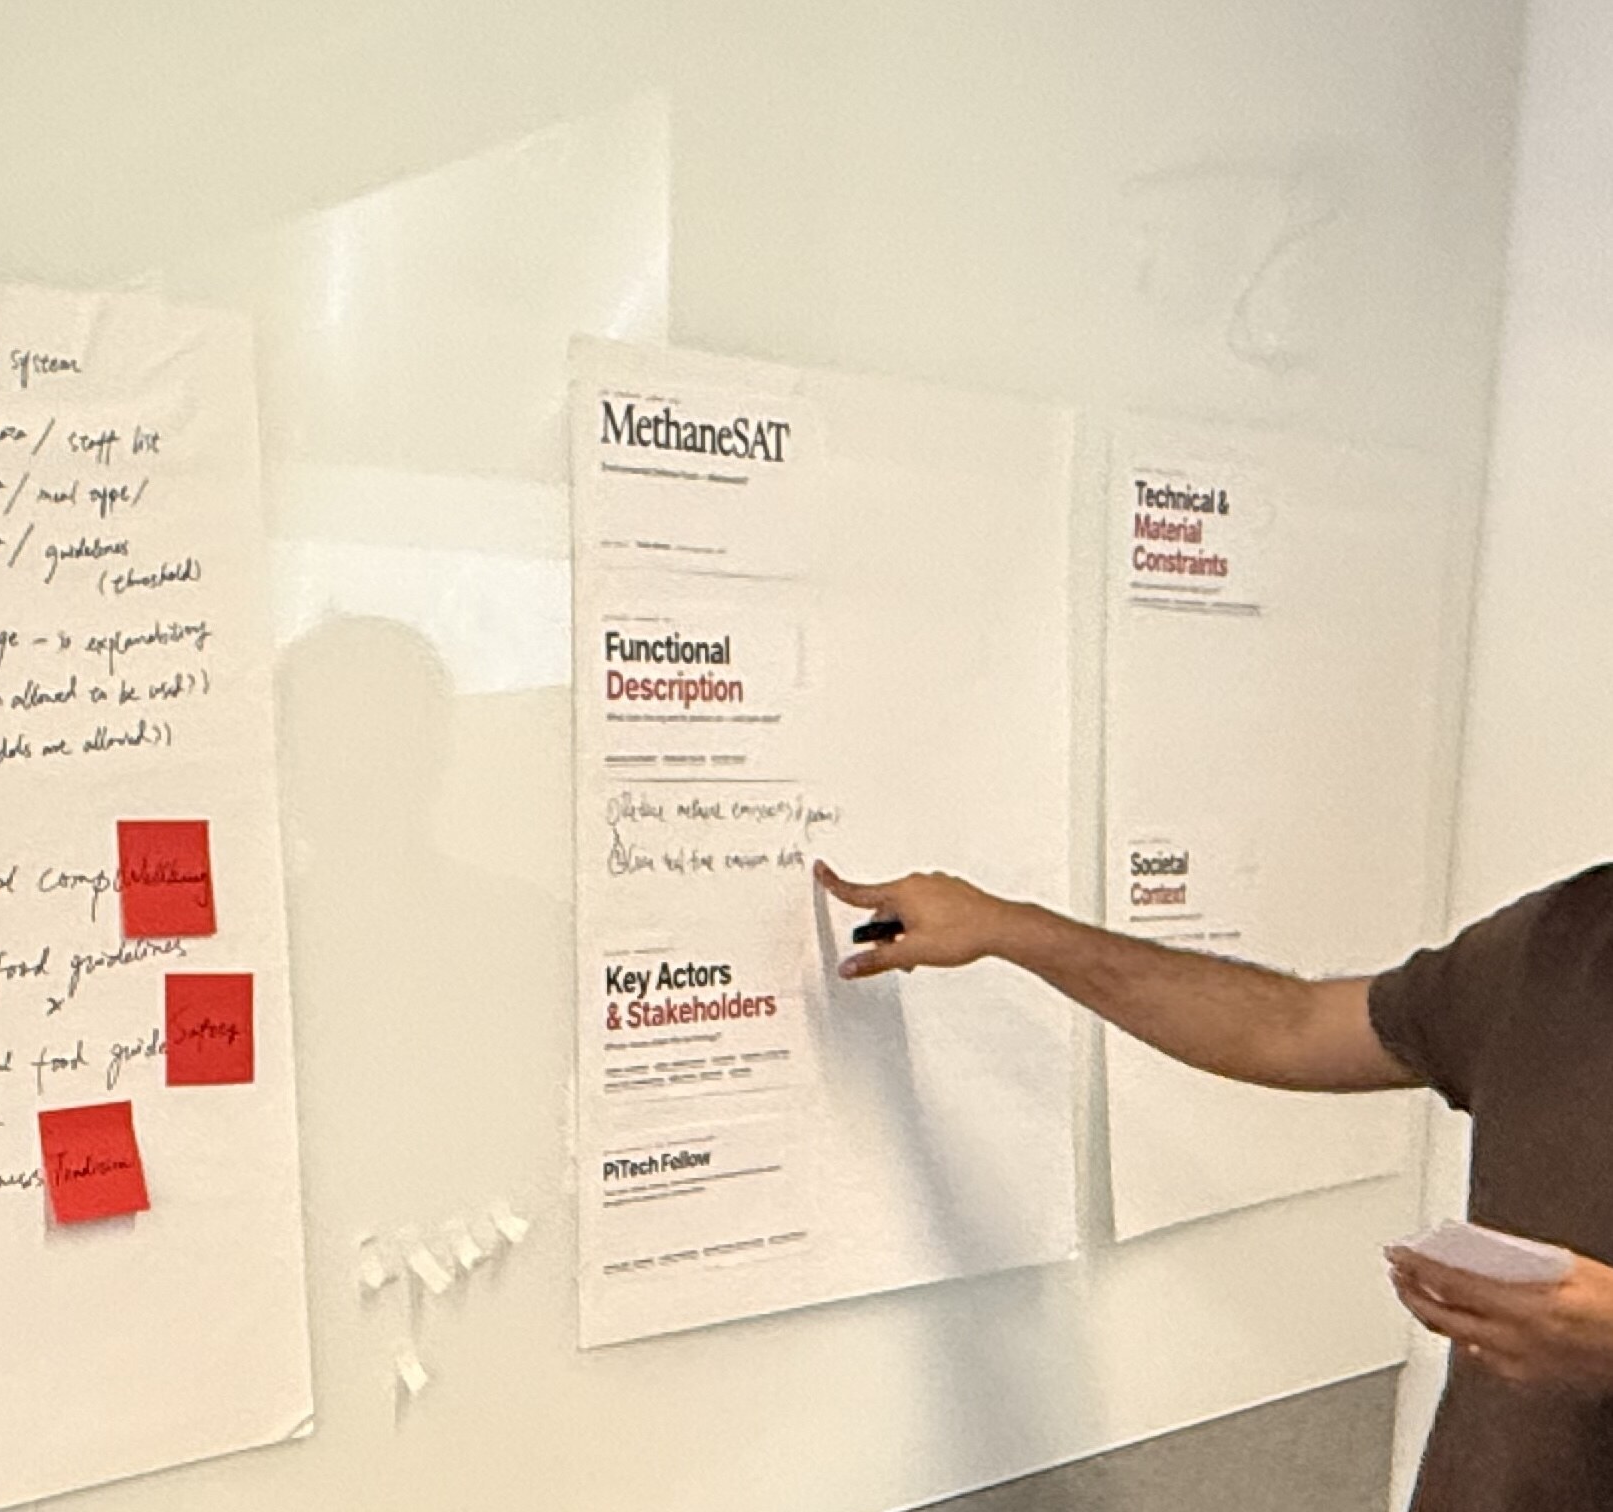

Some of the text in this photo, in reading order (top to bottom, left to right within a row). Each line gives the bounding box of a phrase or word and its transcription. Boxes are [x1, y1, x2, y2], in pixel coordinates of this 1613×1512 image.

[11, 347, 81, 389] system
[68, 429, 120, 465] staff
[601, 399, 789, 462] MethaneSAT
[1135, 480, 1229, 515] Technical &
[1134, 513, 1202, 544] Material
[1132, 545, 1228, 576] Constraints
[605, 631, 730, 664] Functional
[11, 675, 77, 711] allowed
[89, 686, 107, 702] to
[119, 680, 140, 705] be
[606, 669, 743, 710] Description
[1131, 850, 1189, 876] Societal
[1131, 882, 1186, 906] Context
[69, 938, 186, 998] guidelines
[606, 962, 732, 999] Key Actors
[607, 992, 777, 1030] & Stakeholders
[32, 1039, 88, 1096] food
[603, 1151, 711, 1181] PiTech Fellow
